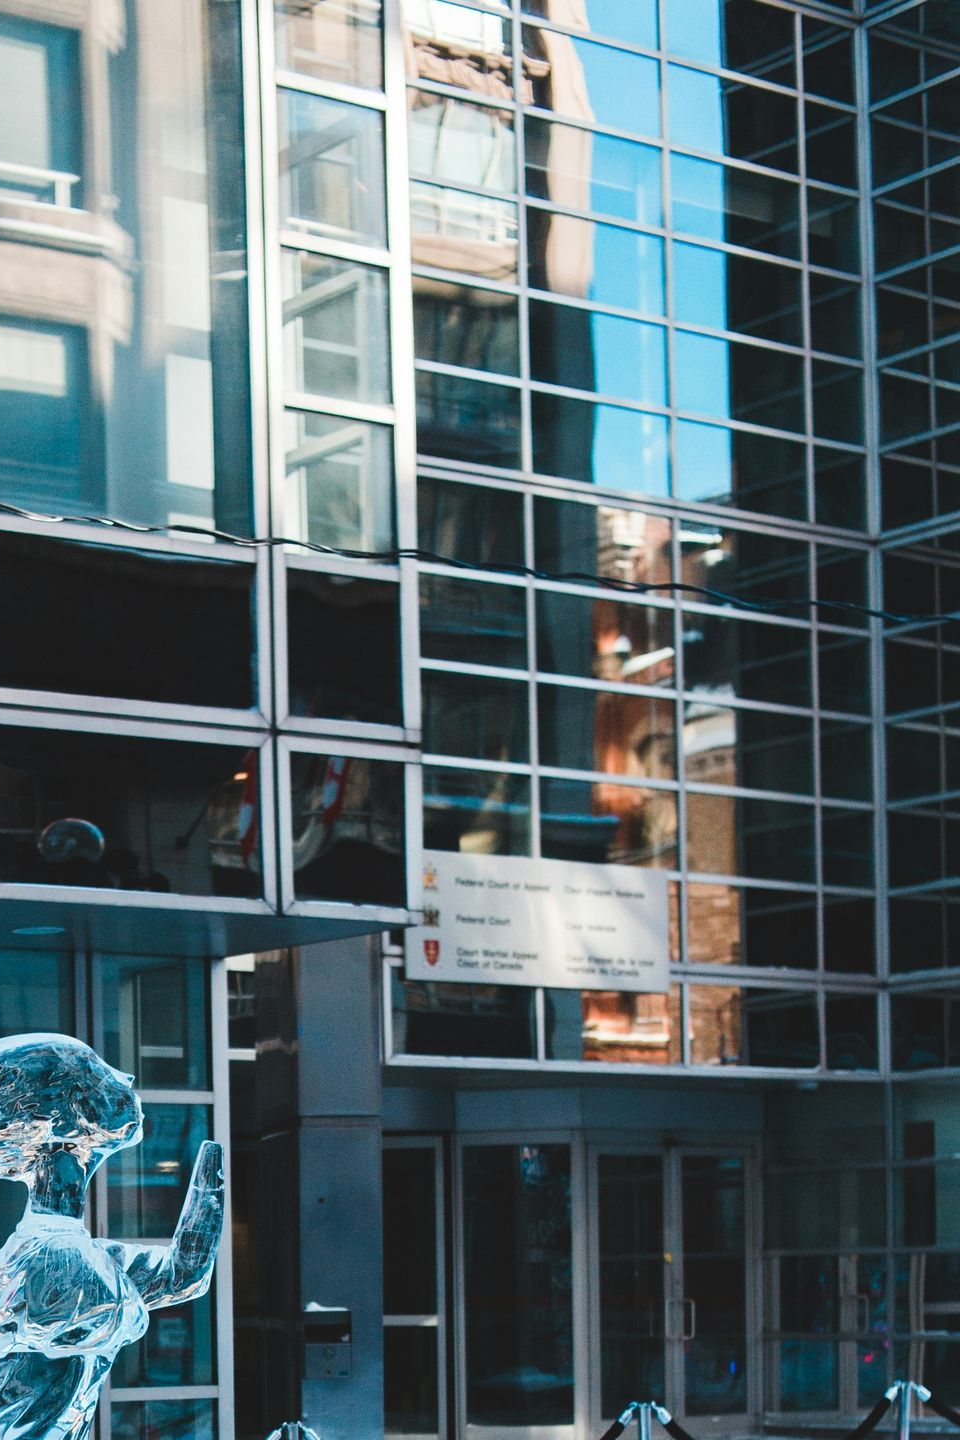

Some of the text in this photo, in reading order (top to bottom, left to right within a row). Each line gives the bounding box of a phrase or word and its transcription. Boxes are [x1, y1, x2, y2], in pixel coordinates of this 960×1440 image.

[455, 878, 484, 889] Federal
[487, 880, 510, 889] Court
[456, 914, 511, 926] Federal Court
[456, 948, 479, 957] Court
[456, 959, 479, 969] Court
[493, 961, 523, 971] Canada
